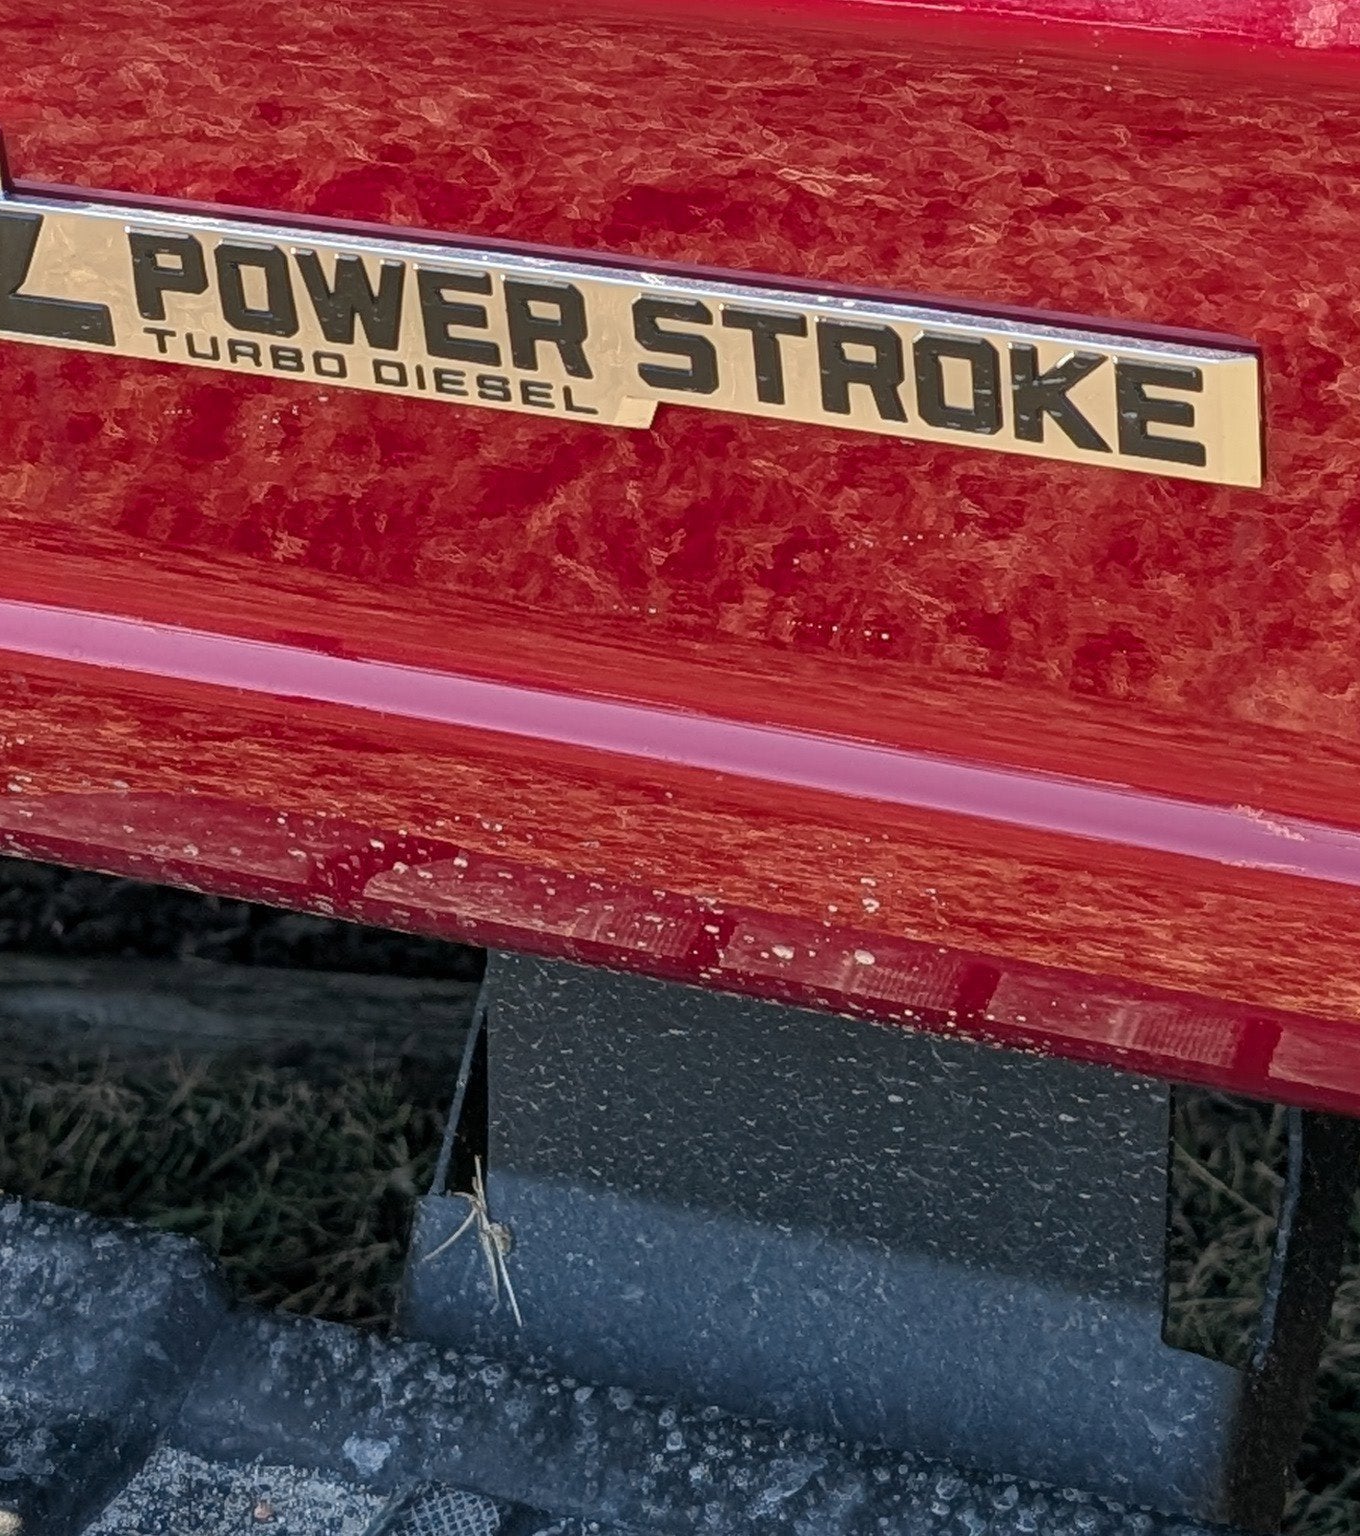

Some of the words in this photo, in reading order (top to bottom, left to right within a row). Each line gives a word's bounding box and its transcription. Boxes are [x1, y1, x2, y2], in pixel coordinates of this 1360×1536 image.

[126, 225, 594, 380] POWER
[631, 292, 1208, 468] STROKE
[142, 325, 348, 379] TURBO
[373, 357, 599, 416] DIESEL
